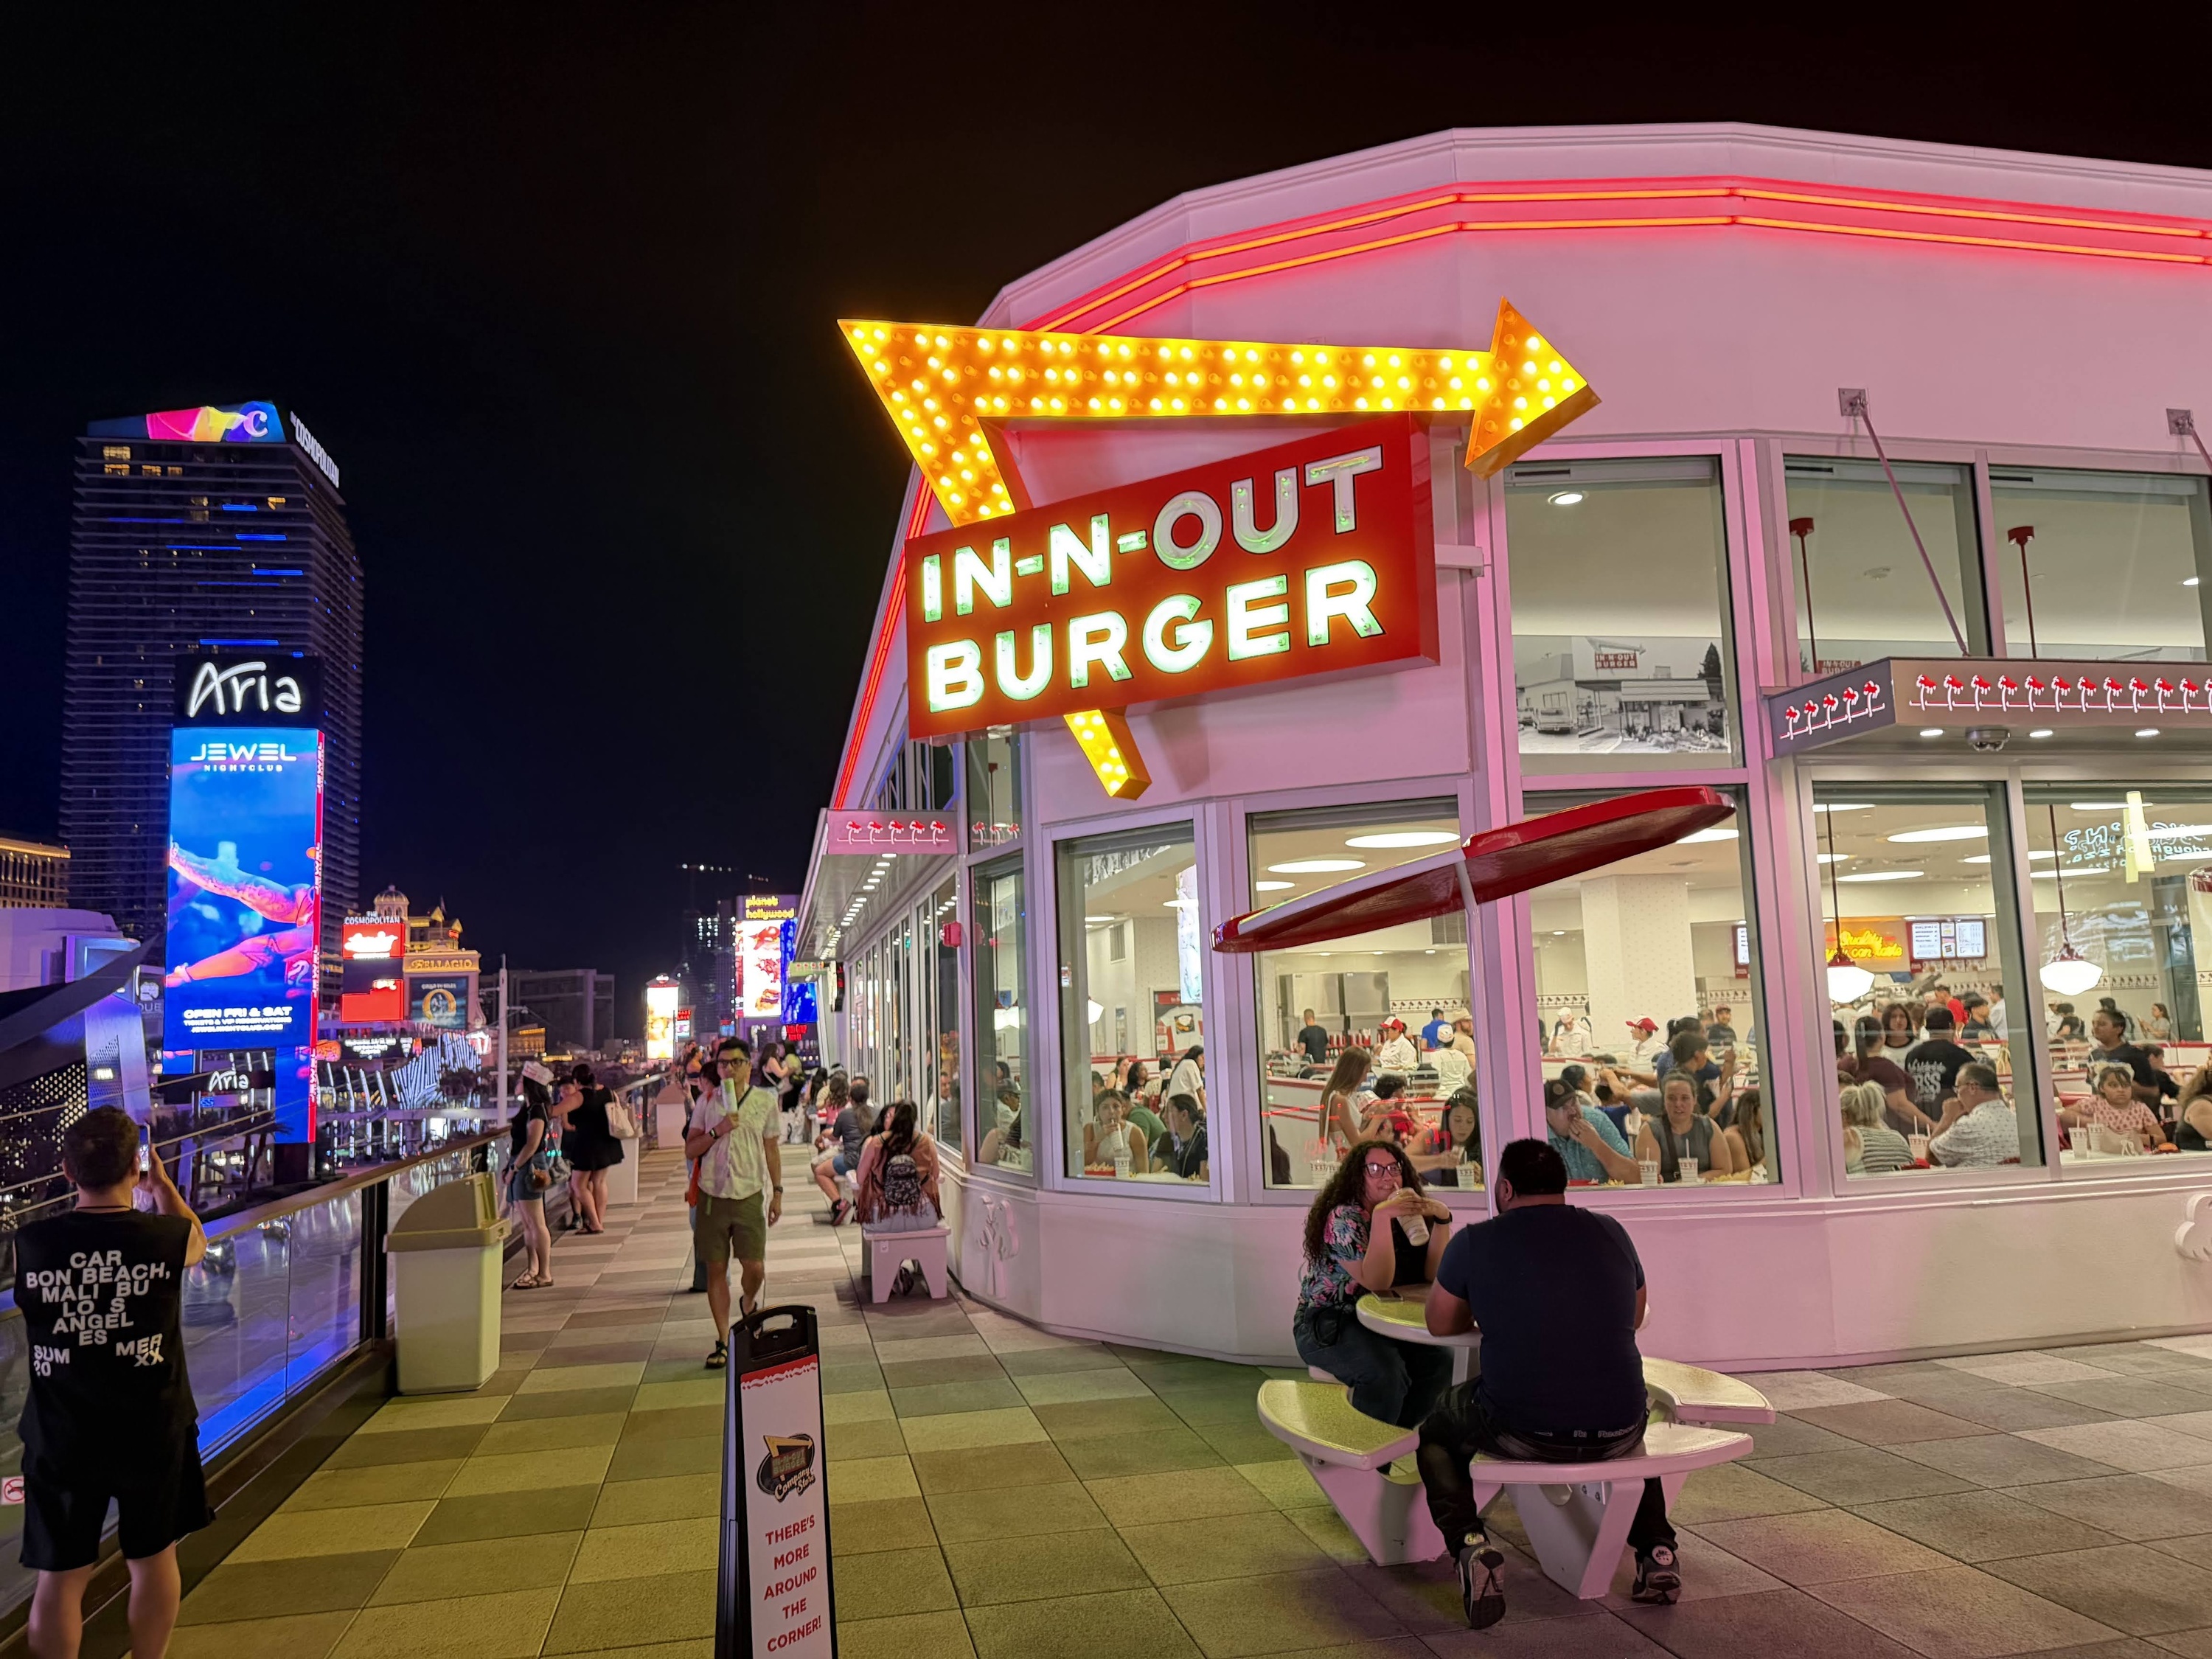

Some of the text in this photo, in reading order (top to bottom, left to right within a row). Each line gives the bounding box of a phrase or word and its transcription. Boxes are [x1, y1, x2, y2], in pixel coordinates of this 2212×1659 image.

[922, 445, 1384, 623] IN-N-OUT
[926, 560, 1385, 714] BURGER
[187, 661, 302, 717] Aria
[190, 743, 297, 761] JEWEL
[344, 917, 400, 925] COSMOPOLITAN
[746, 908, 795, 920] hollywood
[1851, 947, 1872, 959] can
[184, 1006, 293, 1019] OPEN FRI & SAT
[209, 1071, 248, 1092] Aria
[69, 1250, 122, 1270] CAR
[26, 1262, 171, 1289] BON BEACH,
[42, 1280, 150, 1304] MALI BU
[63, 1297, 125, 1318] LO S
[52, 1312, 134, 1335] ANGEL
[79, 1329, 108, 1346] ES
[34, 1344, 70, 1365] SUM
[775, 1467, 810, 1500] Company
[797, 1475, 815, 1494] Store
[765, 1514, 815, 1546] THERE'S
[773, 1543, 810, 1571] MORE
[764, 1565, 817, 1601] AROUND
[782, 1597, 807, 1620] THE
[767, 1615, 821, 1652] CORNER!
